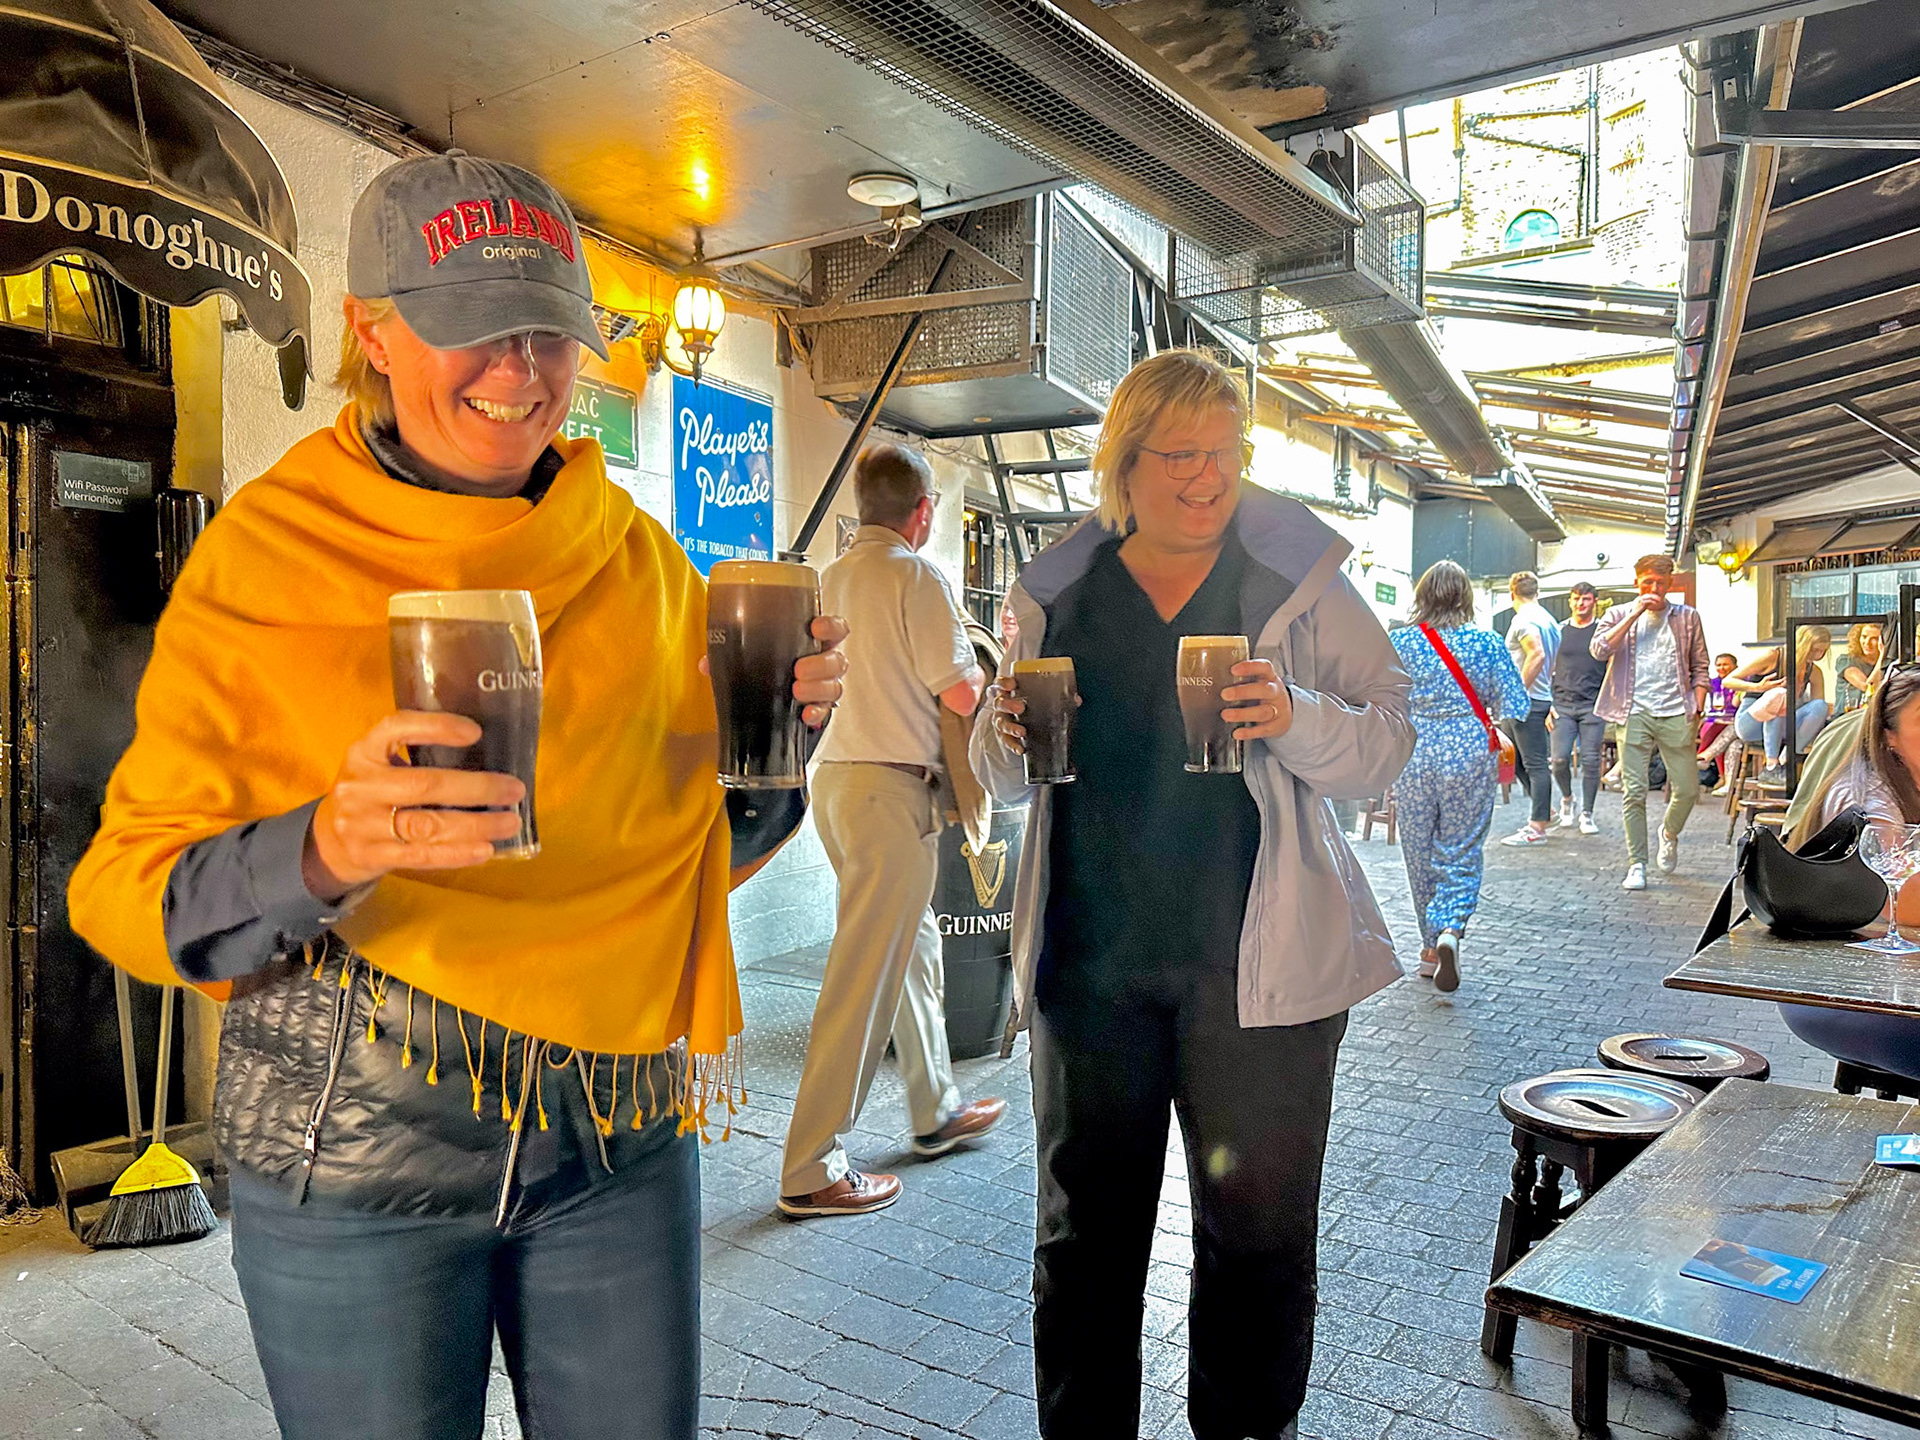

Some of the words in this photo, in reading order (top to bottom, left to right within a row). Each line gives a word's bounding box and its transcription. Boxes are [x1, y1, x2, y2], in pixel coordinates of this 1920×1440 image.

[0, 169, 284, 301] Donoghue's
[422, 199, 575, 267] IRELAND
[482, 246, 541, 261] Original
[680, 408, 769, 471] Player's
[65, 479, 83, 489] Wifi
[86, 482, 128, 495] Password
[65, 491, 122, 505] MerrionRow
[696, 467, 771, 527] Please
[684, 537, 695, 552] IT'S
[697, 539, 707, 554] THE
[709, 541, 735, 558] TOBACCO
[735, 546, 748, 560] THAT
[936, 911, 1014, 936] GUINNE
